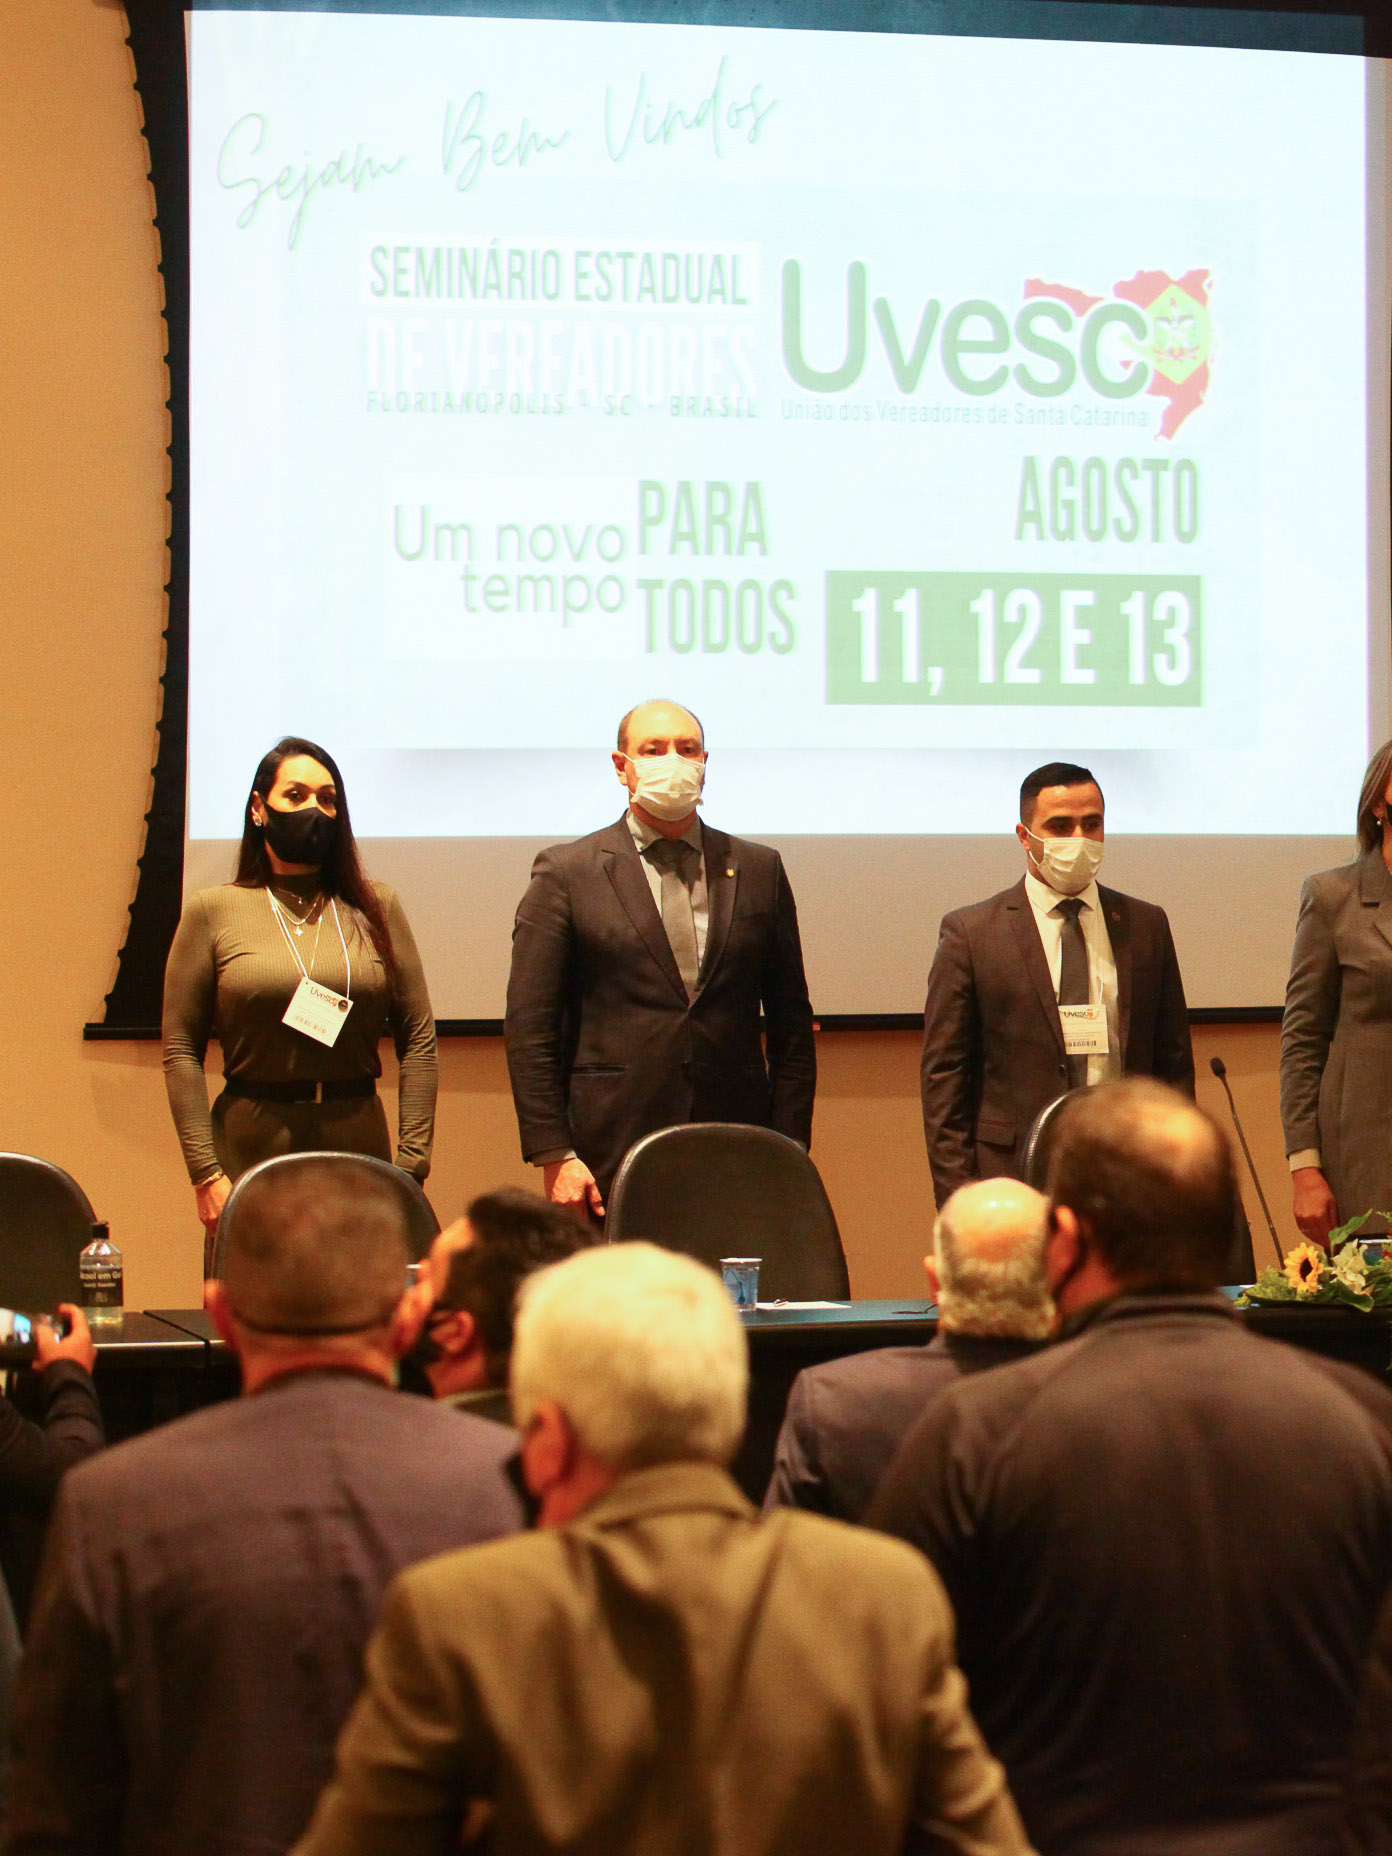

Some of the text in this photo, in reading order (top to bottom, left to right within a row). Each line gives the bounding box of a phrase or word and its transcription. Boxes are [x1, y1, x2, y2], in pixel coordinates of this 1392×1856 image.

[217, 55, 779, 251] Sejam Bem Vindos
[370, 237, 749, 306] SEMINÁRIO ESTADUAL
[366, 315, 758, 406] DE VEREADORES
[781, 257, 1149, 400] Uvesc
[603, 393, 632, 417] SC
[670, 394, 757, 419] BRASIL
[780, 399, 1148, 427] União dos Vereadores de Santa Catarina
[393, 504, 627, 563] Um novo
[638, 479, 770, 556] PARA
[1014, 455, 1199, 543] AGOSTO
[460, 564, 627, 628] tempo
[636, 578, 798, 655] TODOS
[852, 587, 1191, 696] 11, 12 E 13
